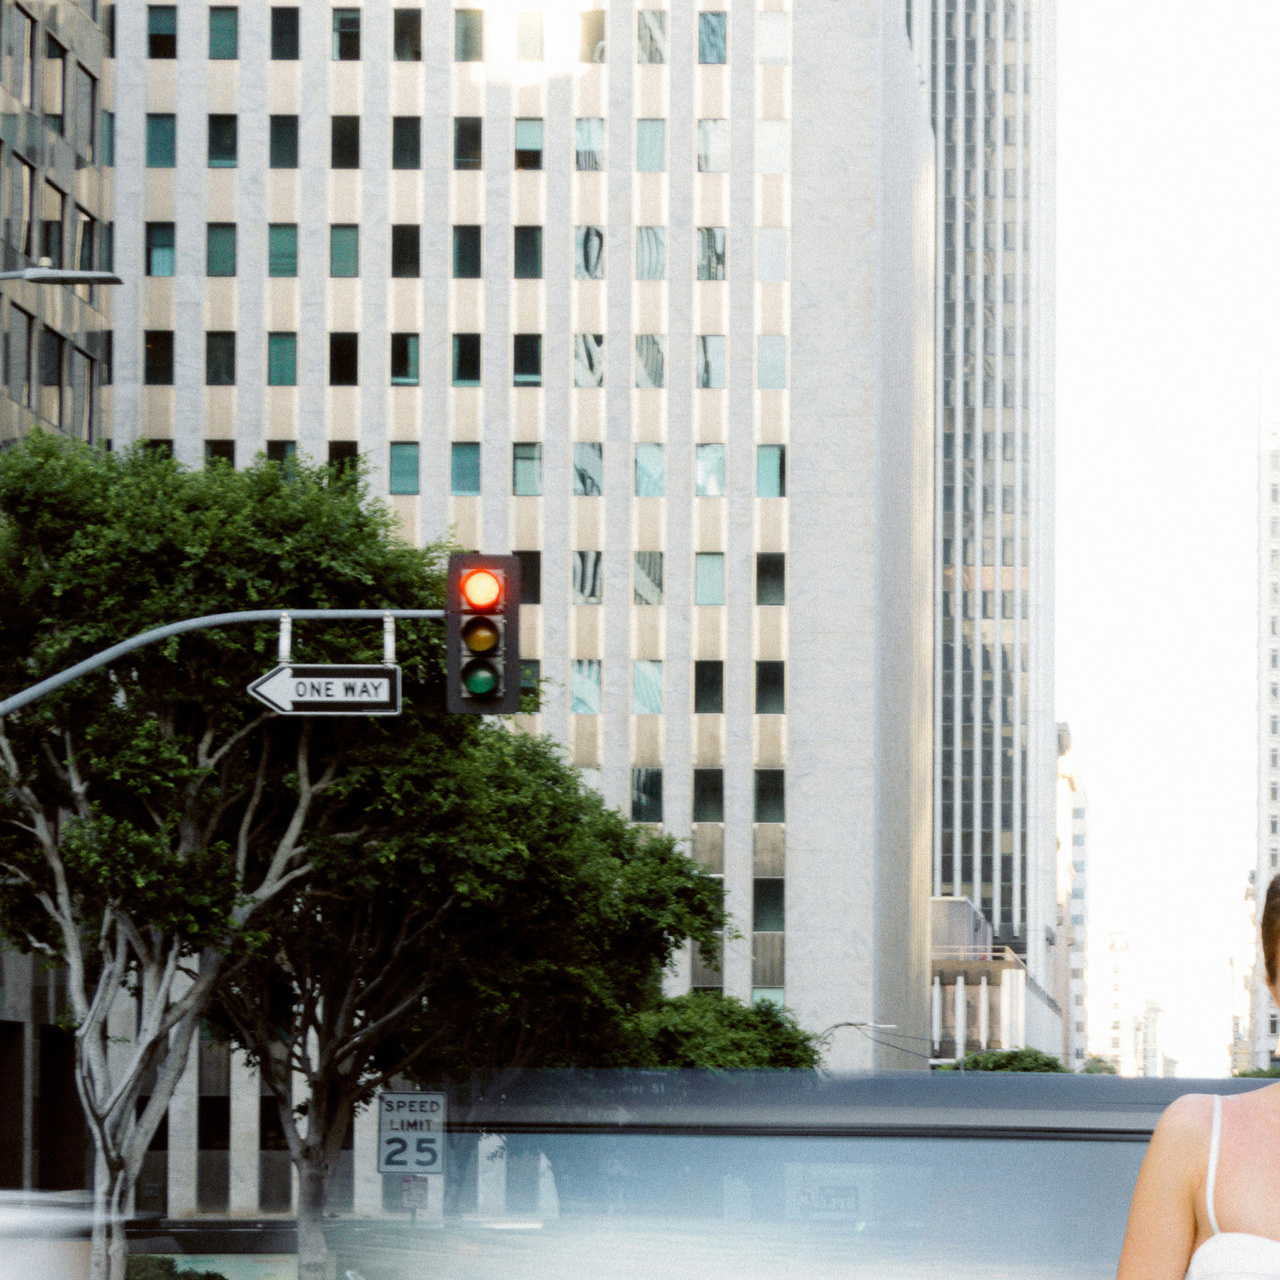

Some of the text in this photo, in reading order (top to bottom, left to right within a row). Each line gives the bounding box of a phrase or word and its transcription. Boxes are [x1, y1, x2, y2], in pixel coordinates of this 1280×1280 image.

[295, 682, 382, 697] ONE WAY
[385, 1101, 440, 1113] SPEED
[390, 1119, 432, 1131] LIMIT
[384, 1137, 438, 1166] 25
